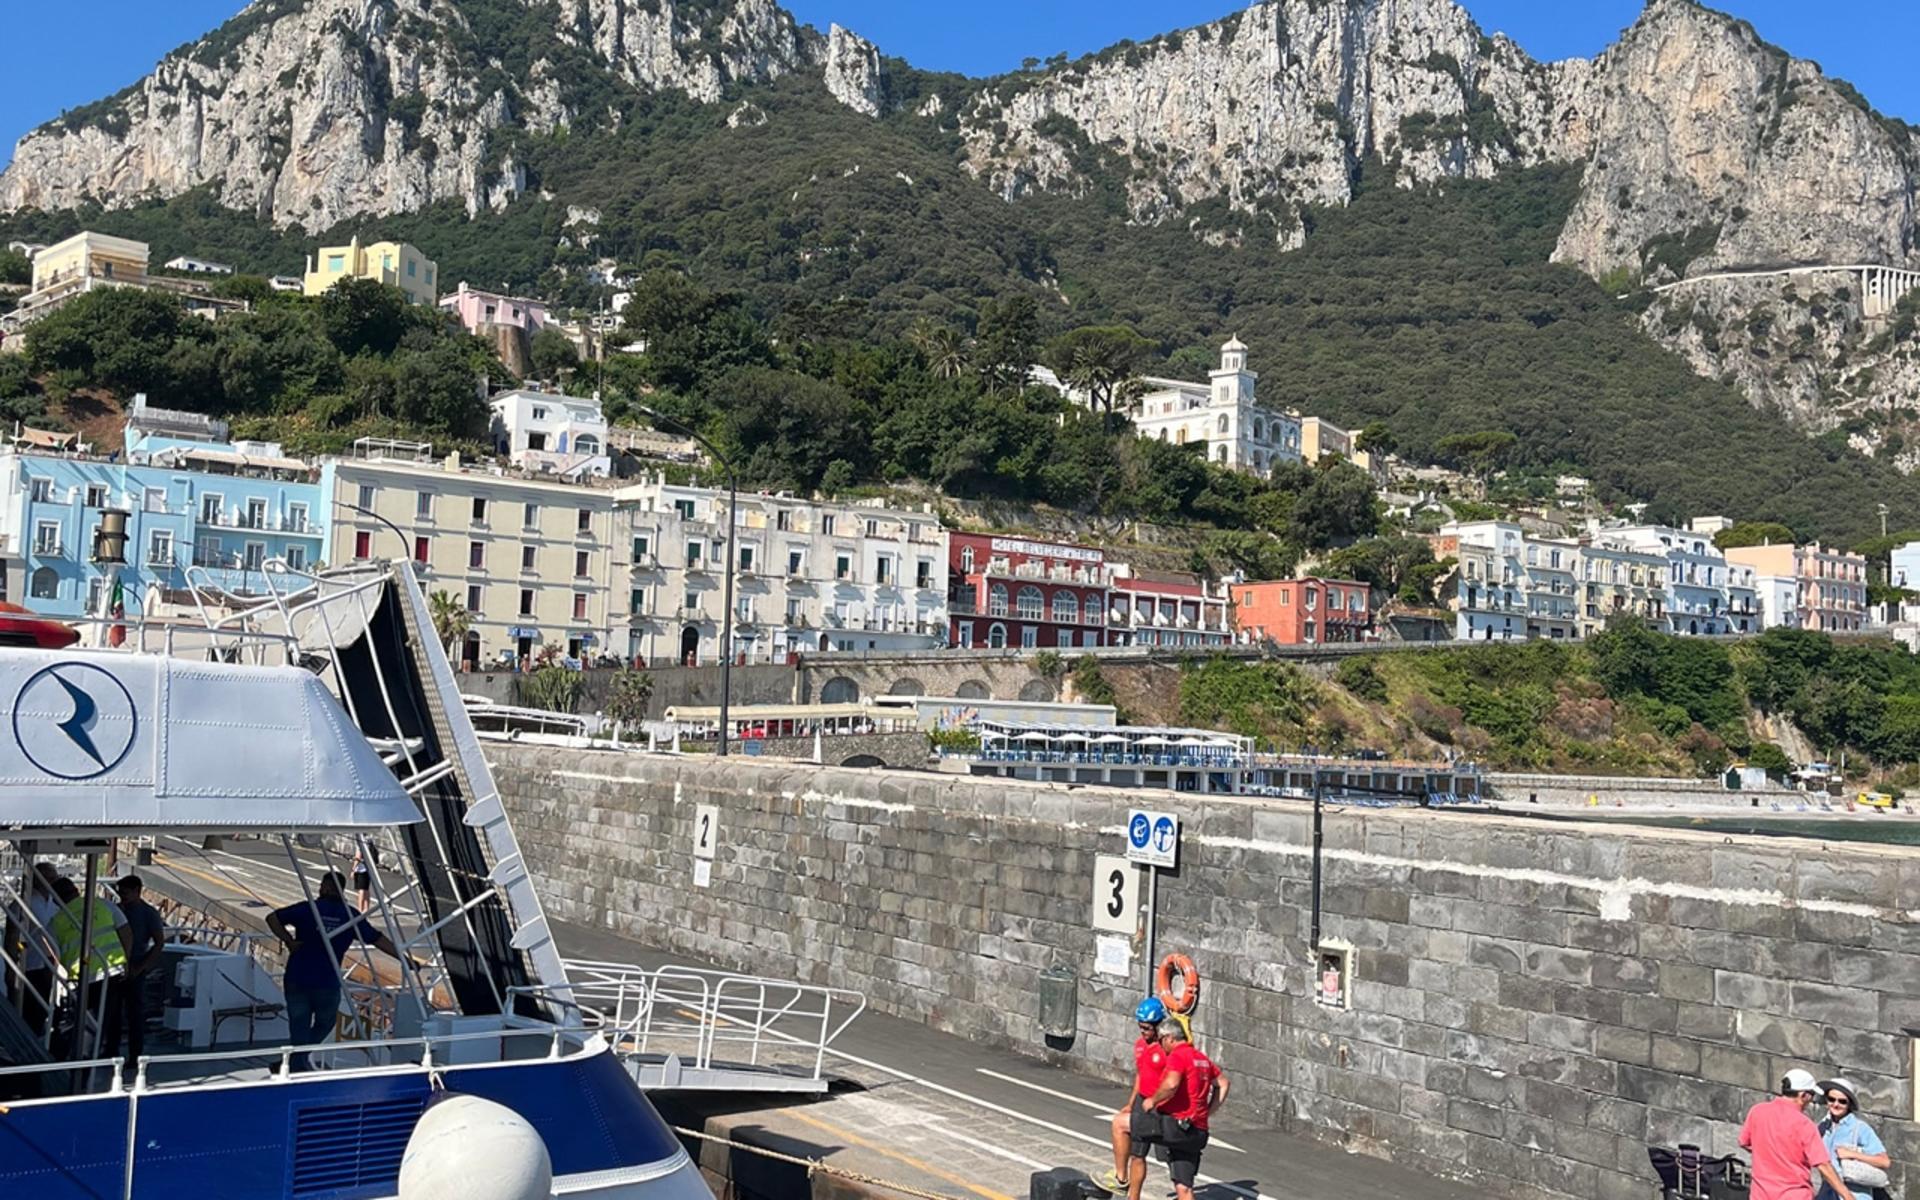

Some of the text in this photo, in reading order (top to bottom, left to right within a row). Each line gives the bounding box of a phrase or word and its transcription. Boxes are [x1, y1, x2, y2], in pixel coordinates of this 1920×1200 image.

[994, 540, 1019, 551] HOTEL
[700, 814, 709, 848] 2
[1107, 869, 1124, 918] 3
